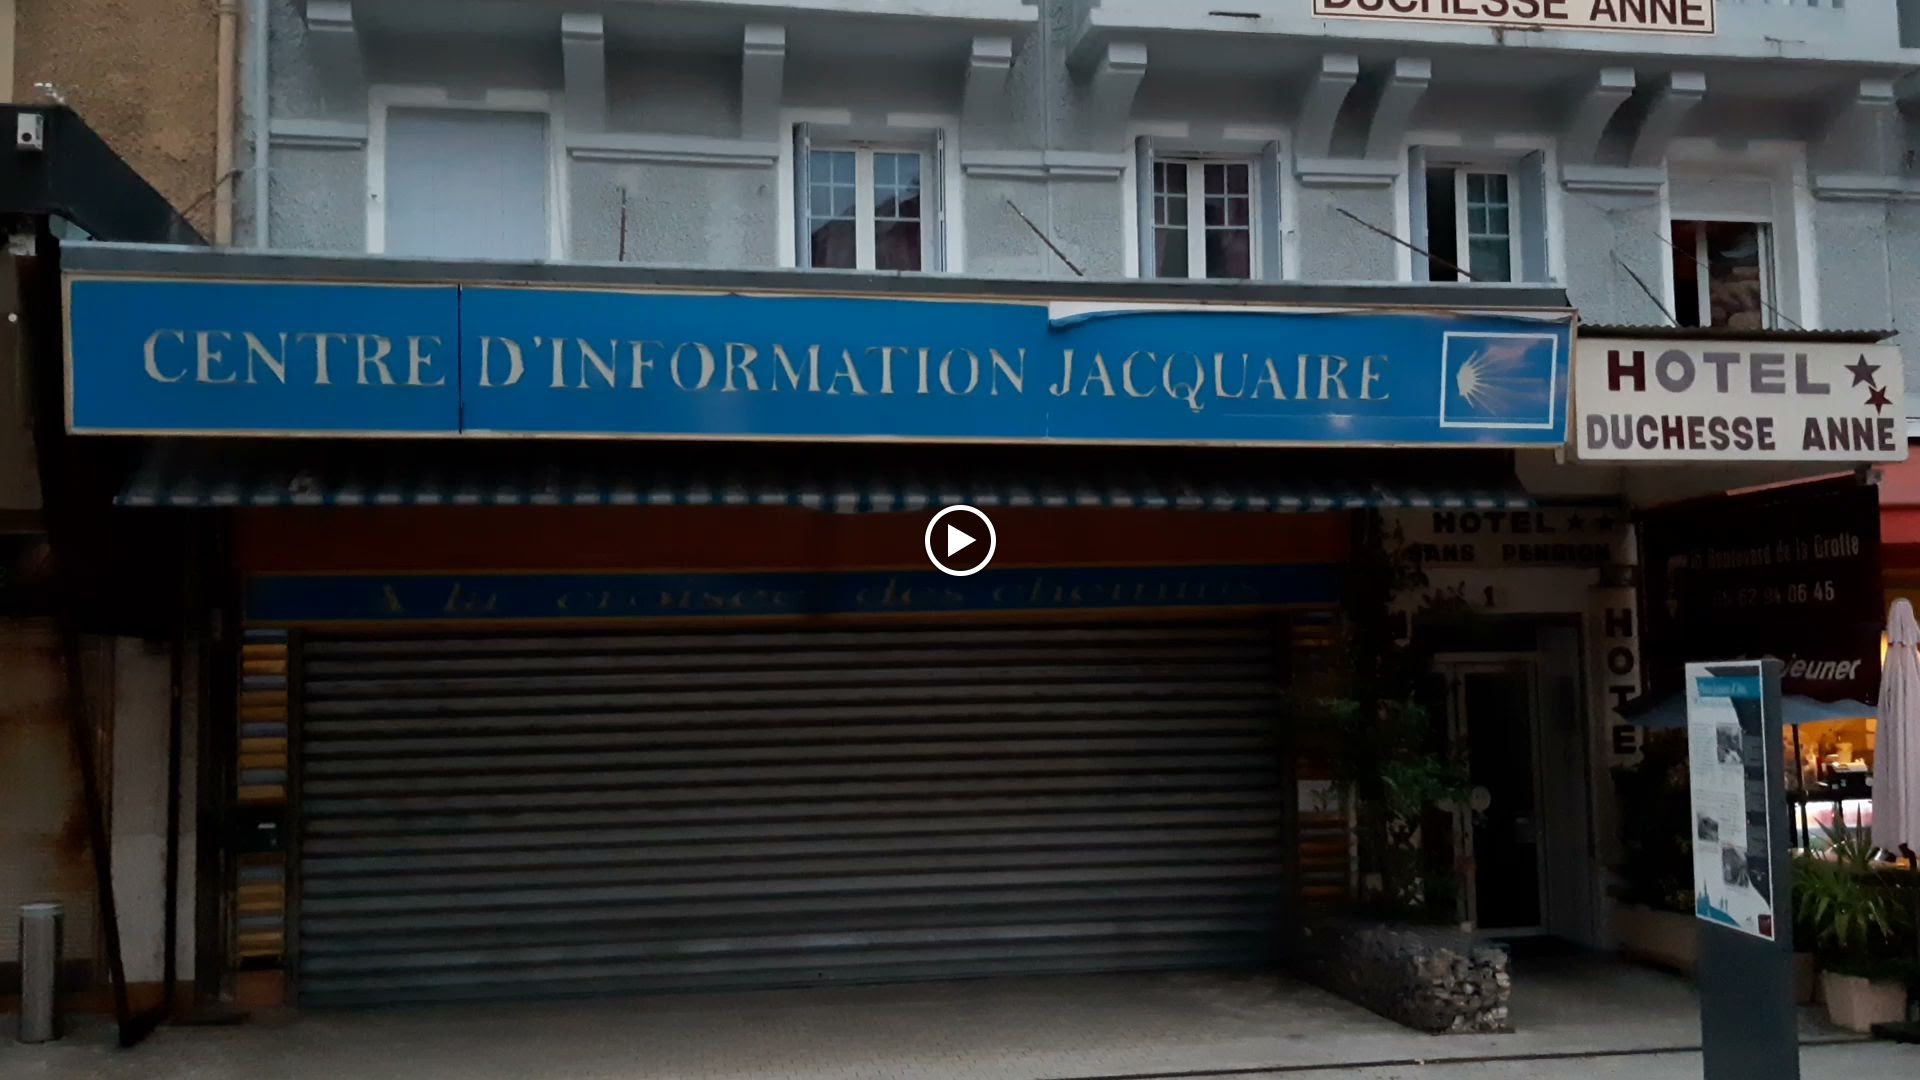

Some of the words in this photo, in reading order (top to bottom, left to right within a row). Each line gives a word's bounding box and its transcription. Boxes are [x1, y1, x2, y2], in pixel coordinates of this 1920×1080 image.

[1589, 0, 1705, 26] ANNE
[143, 327, 447, 387] CENTRE
[478, 335, 1027, 397] D'INFORMATION
[1048, 347, 1391, 411] JACQUAIRE
[1606, 349, 1831, 395] HOTEL
[1586, 414, 1775, 451] DUCHESSE
[1802, 416, 1896, 451] ANNE
[1433, 511, 1555, 533] HOTEL
[1776, 538, 1792, 563] de
[1796, 536, 1809, 561] la
[1813, 531, 1860, 559] Grotte
[1788, 583, 1808, 604] 06
[1604, 608, 1638, 754] HOTE
